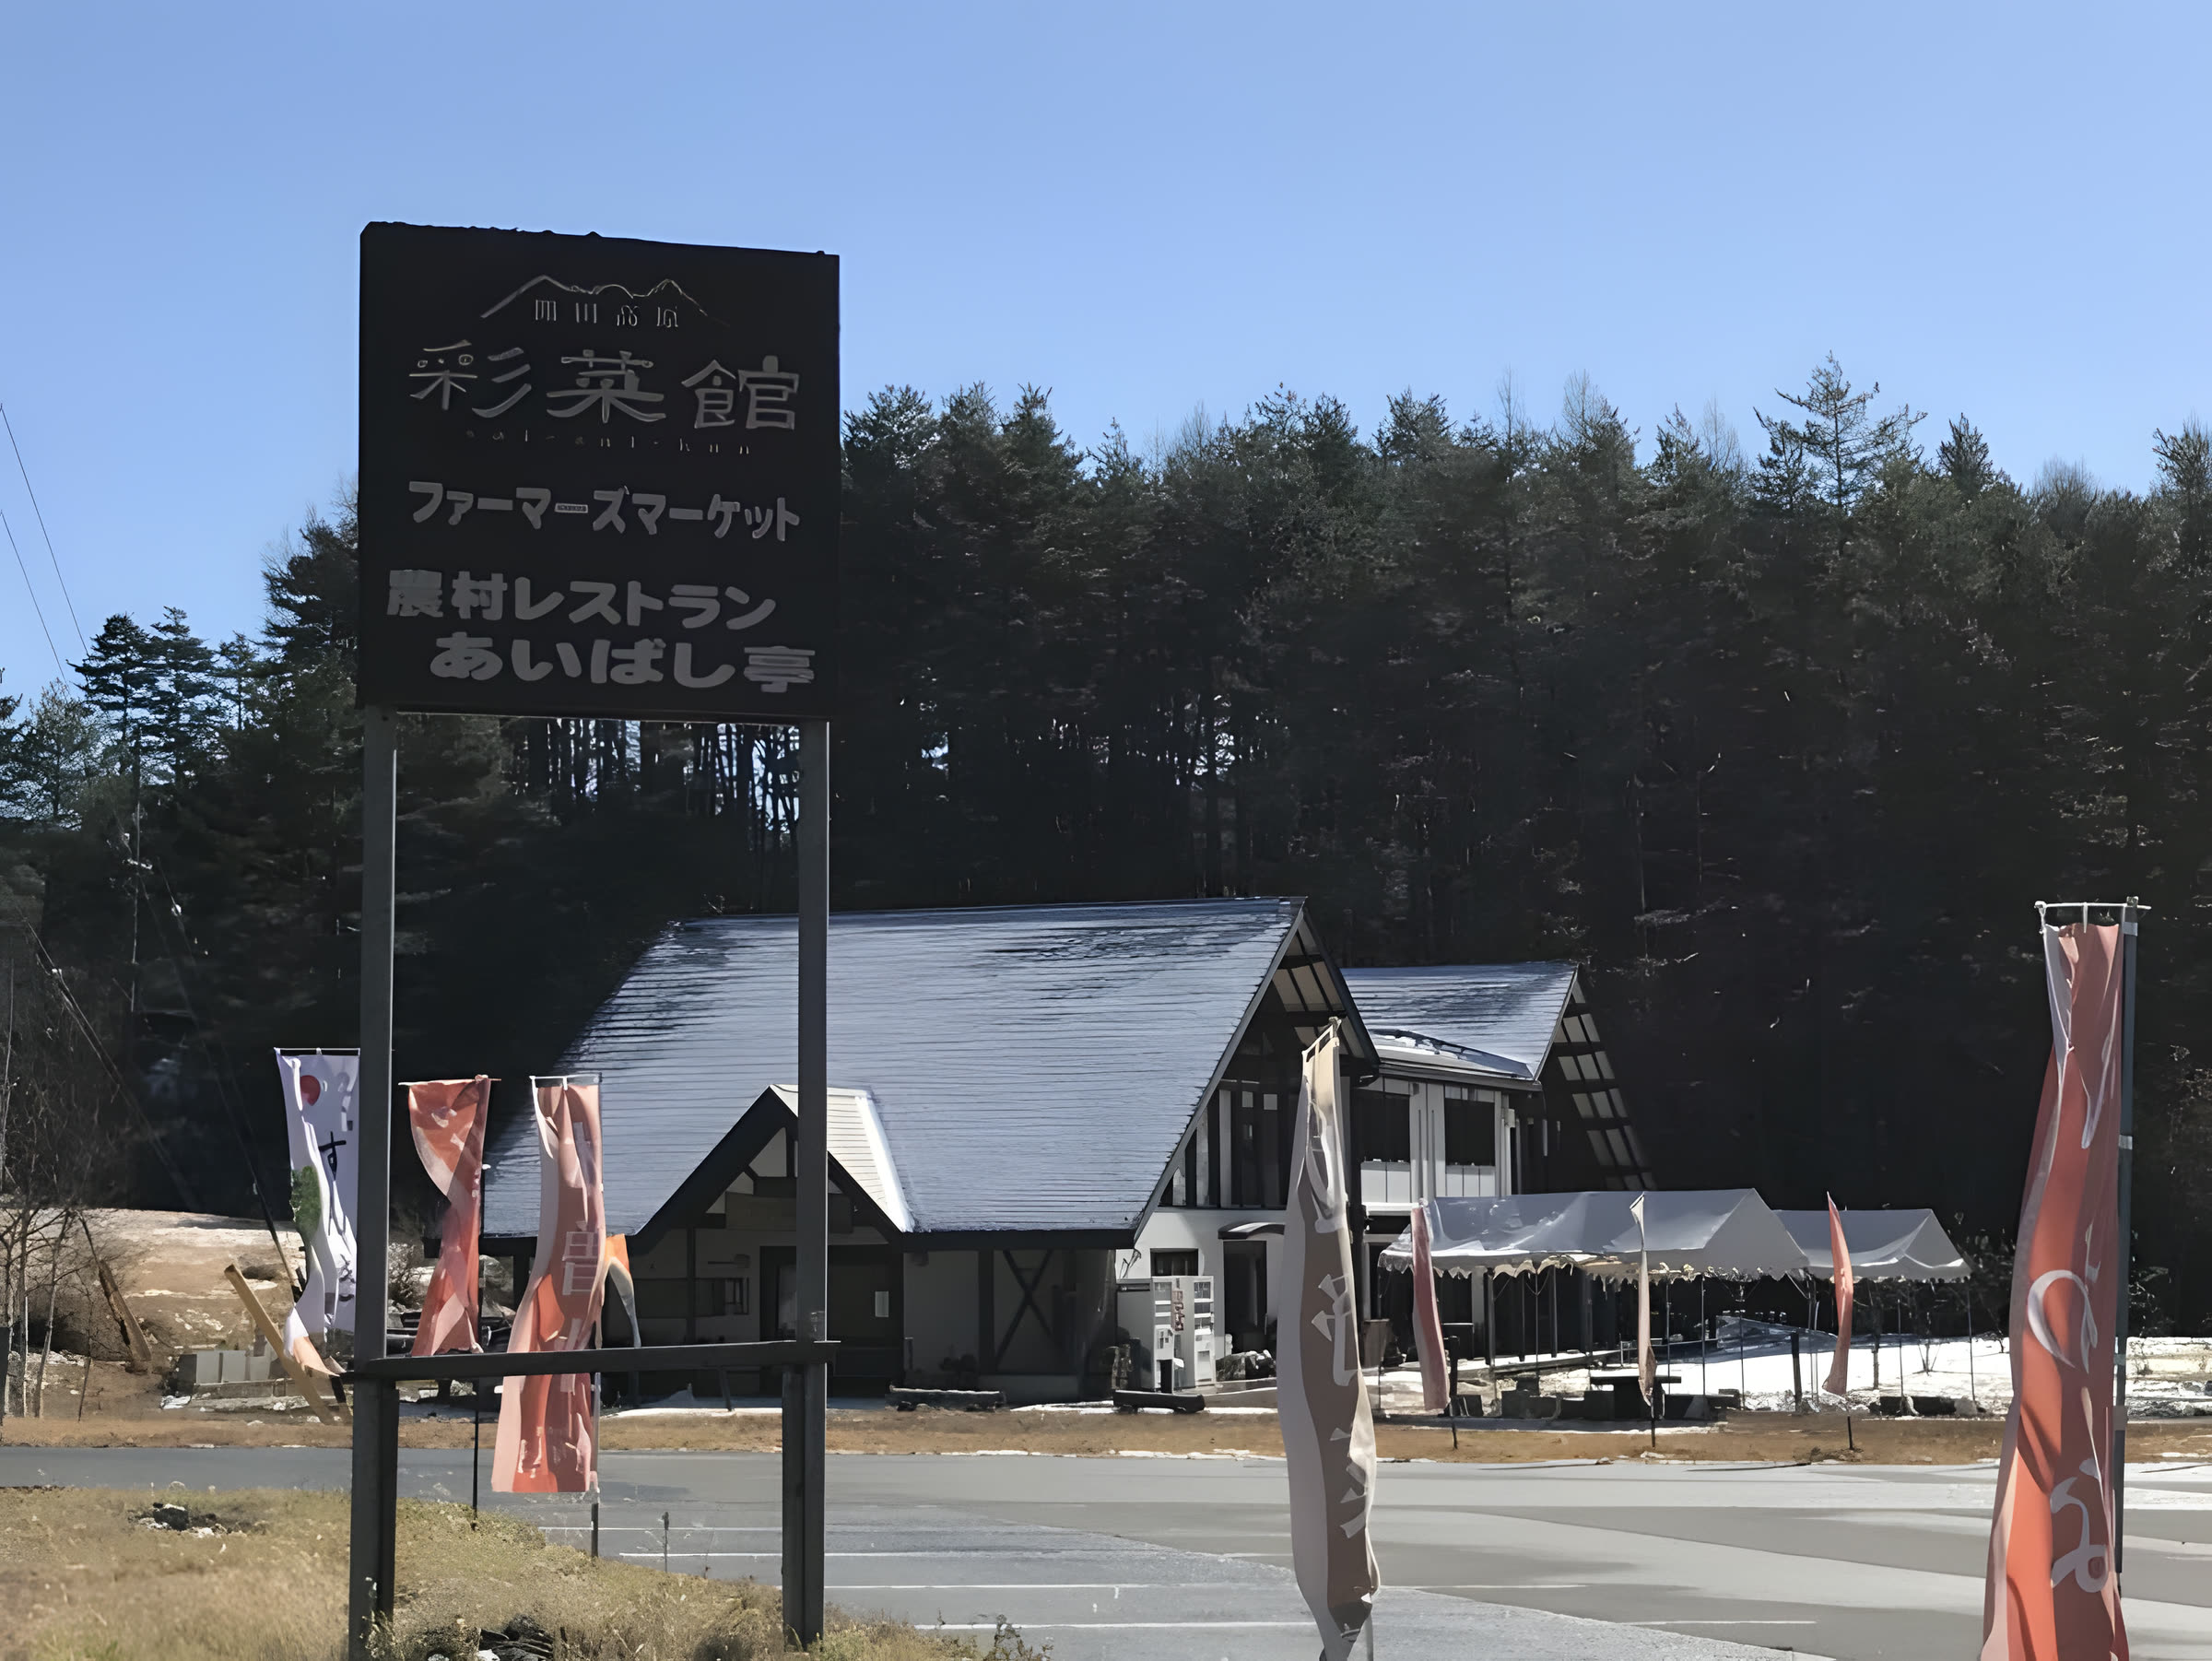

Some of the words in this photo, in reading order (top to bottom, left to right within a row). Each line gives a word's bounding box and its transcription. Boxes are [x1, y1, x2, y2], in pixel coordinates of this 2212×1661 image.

[409, 340, 799, 429] 彩菜館
[409, 481, 800, 541] ファーマーズマーケット
[387, 570, 776, 630] 農村レストラン
[429, 631, 815, 693] あいばし亭
